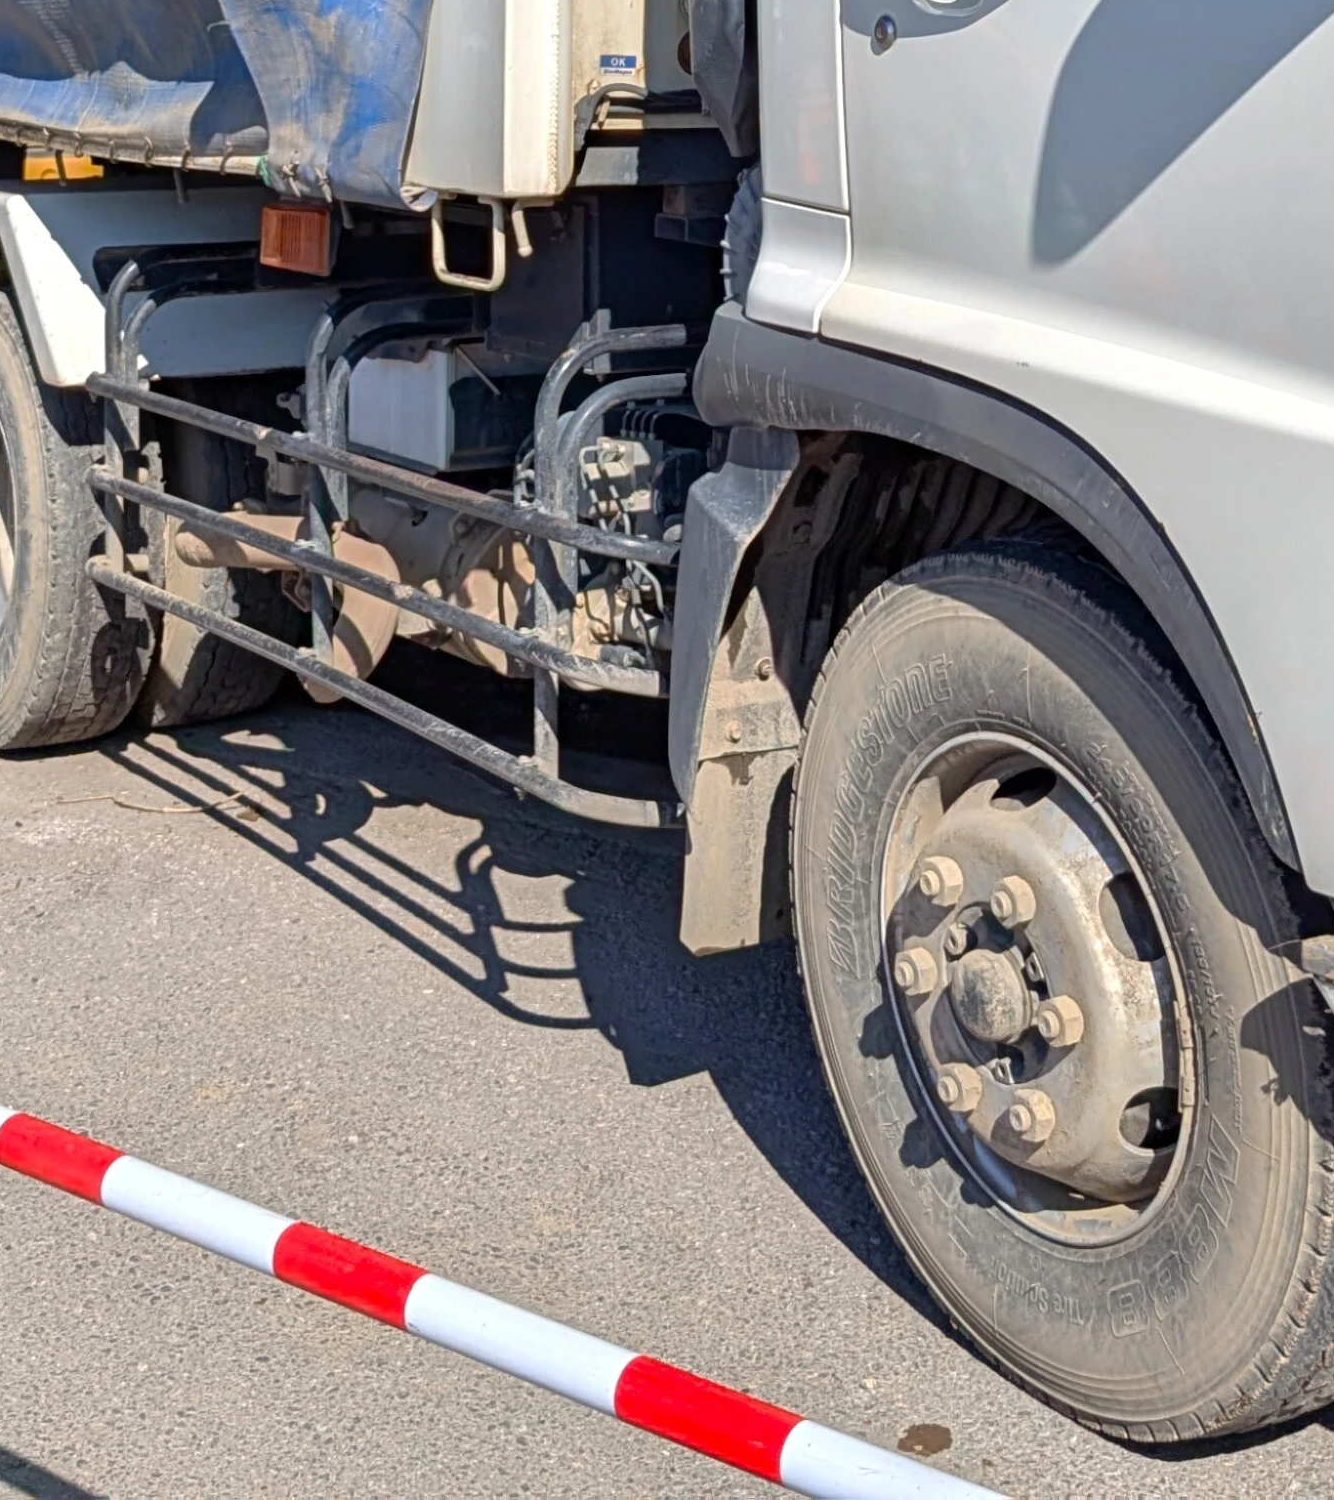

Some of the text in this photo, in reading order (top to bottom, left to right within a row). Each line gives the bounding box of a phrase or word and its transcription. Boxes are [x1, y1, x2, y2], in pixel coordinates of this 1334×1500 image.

[610, 57, 626, 67] OK
[827, 653, 953, 981] BRIDGESTONE
[1107, 1113, 1241, 1340] M888
